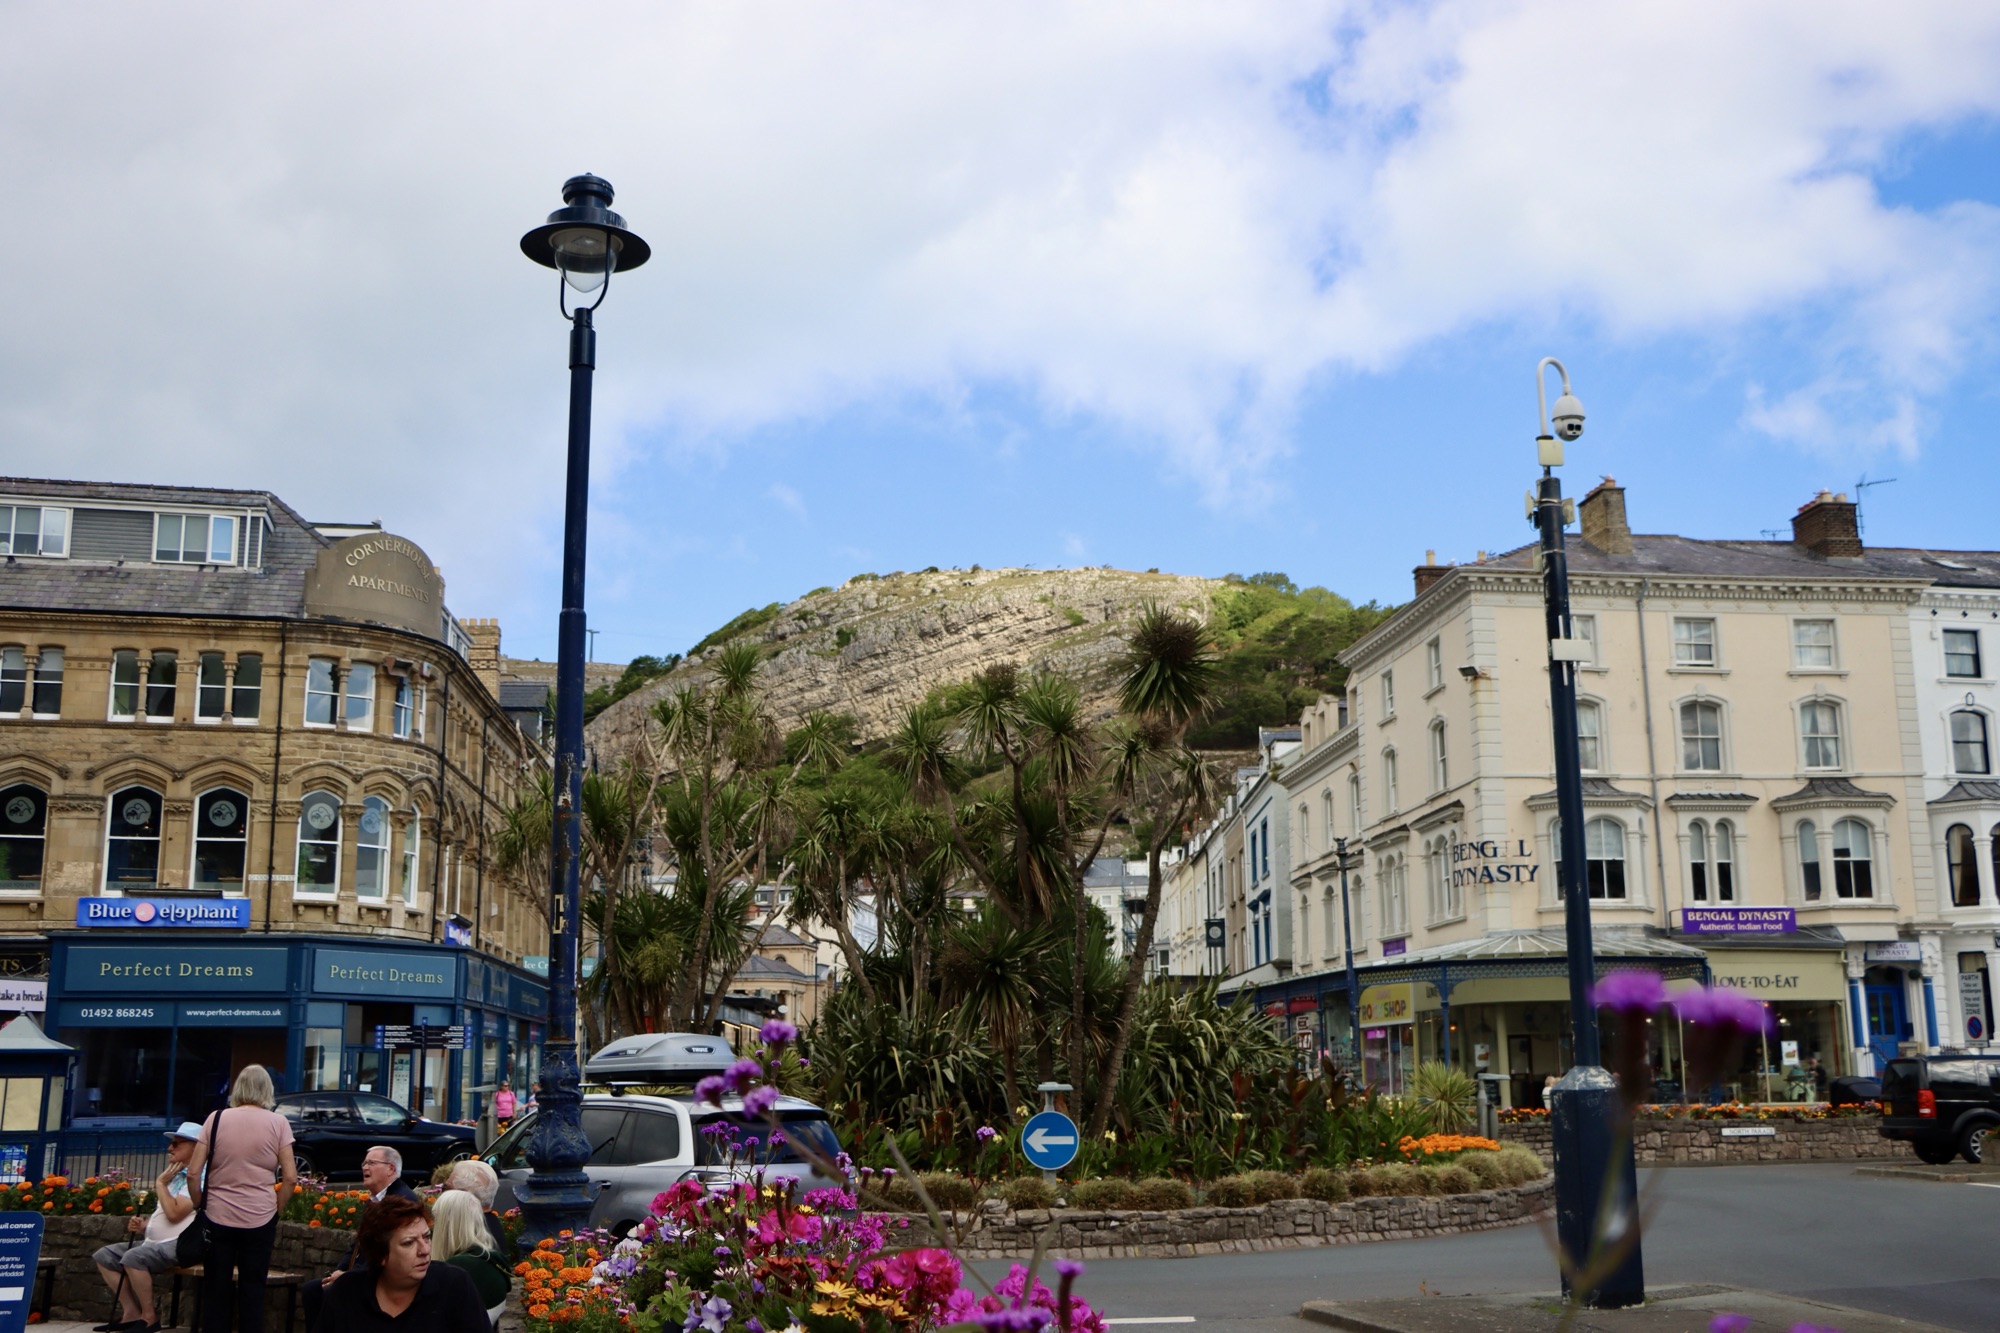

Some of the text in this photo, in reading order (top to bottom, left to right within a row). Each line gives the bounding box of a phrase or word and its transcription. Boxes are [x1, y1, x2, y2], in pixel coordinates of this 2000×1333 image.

[345, 539, 432, 584] CORNERHOUSE
[347, 574, 430, 603] APARTMENTS
[1453, 864, 1539, 888] DYNASTY
[89, 903, 239, 922] Blue elephant
[1687, 911, 1791, 921] BENGAL DYNASTY
[1699, 923, 1736, 931] Authentic
[1737, 923, 1762, 931] Indian
[100, 962, 254, 977] Perfect Dreams
[523, 960, 536, 969] Ice
[330, 965, 444, 984] Perfect Dreams
[0, 989, 44, 1001] ake a break
[81, 1008, 154, 1018] 01492 868245
[186, 1009, 282, 1017] www.perfect-dreams.co.uk
[1384, 1000, 1406, 1018] SHOP
